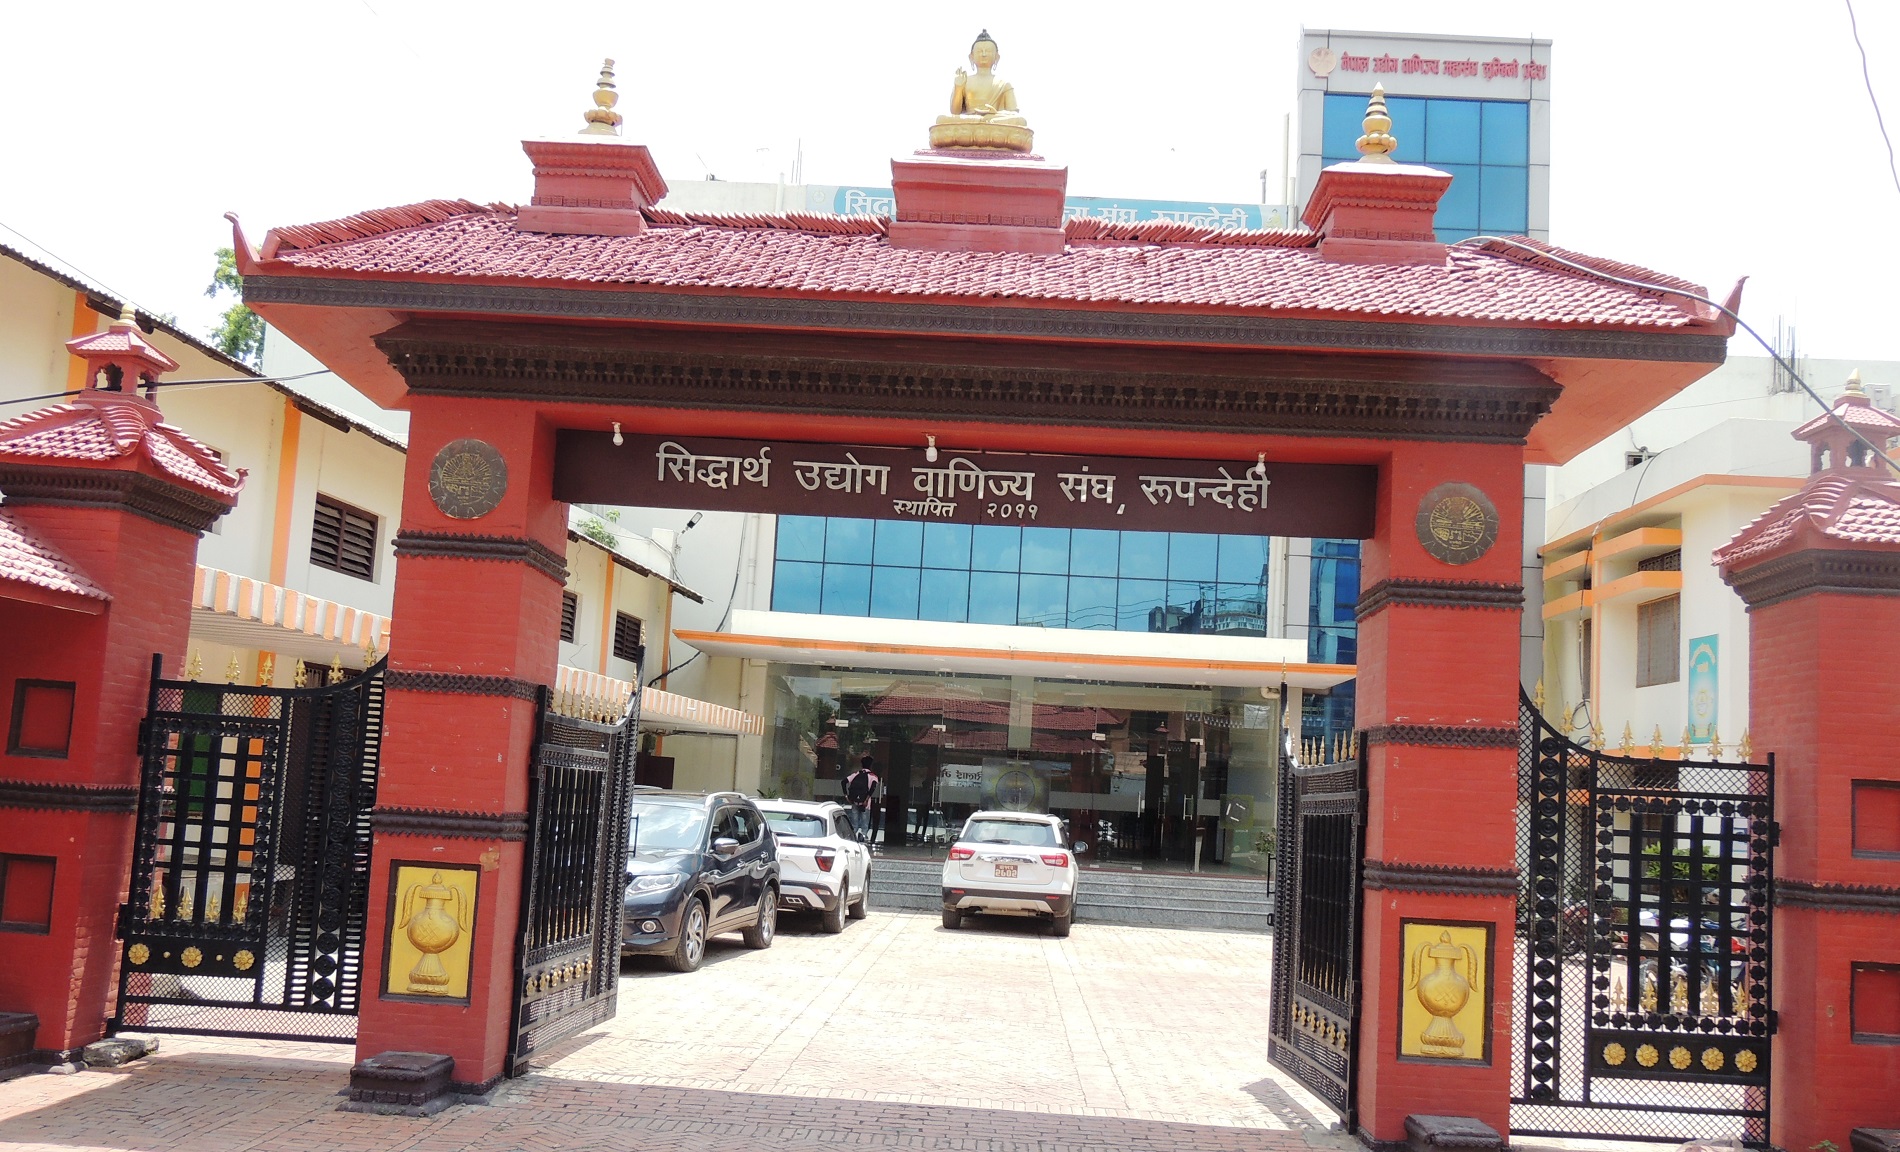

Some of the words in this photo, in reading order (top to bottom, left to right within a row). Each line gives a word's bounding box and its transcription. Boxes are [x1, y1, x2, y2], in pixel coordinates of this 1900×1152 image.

[1341, 51, 1370, 73] नेपाल
[1373, 53, 1399, 74] उद्योग
[1402, 53, 1441, 75] वाणिज्य
[1443, 57, 1479, 78] महासंघ
[1523, 59, 1547, 80] प्रदेश
[656, 441, 772, 490] सिद्धार्थ
[793, 452, 891, 495] उद्योग
[912, 457, 1036, 501] वाणिज्य
[1057, 465, 1126, 515] संघ,
[1139, 466, 1271, 512] रूपन्देही
[893, 497, 958, 518] स्थापित
[986, 502, 1039, 520] २०११
